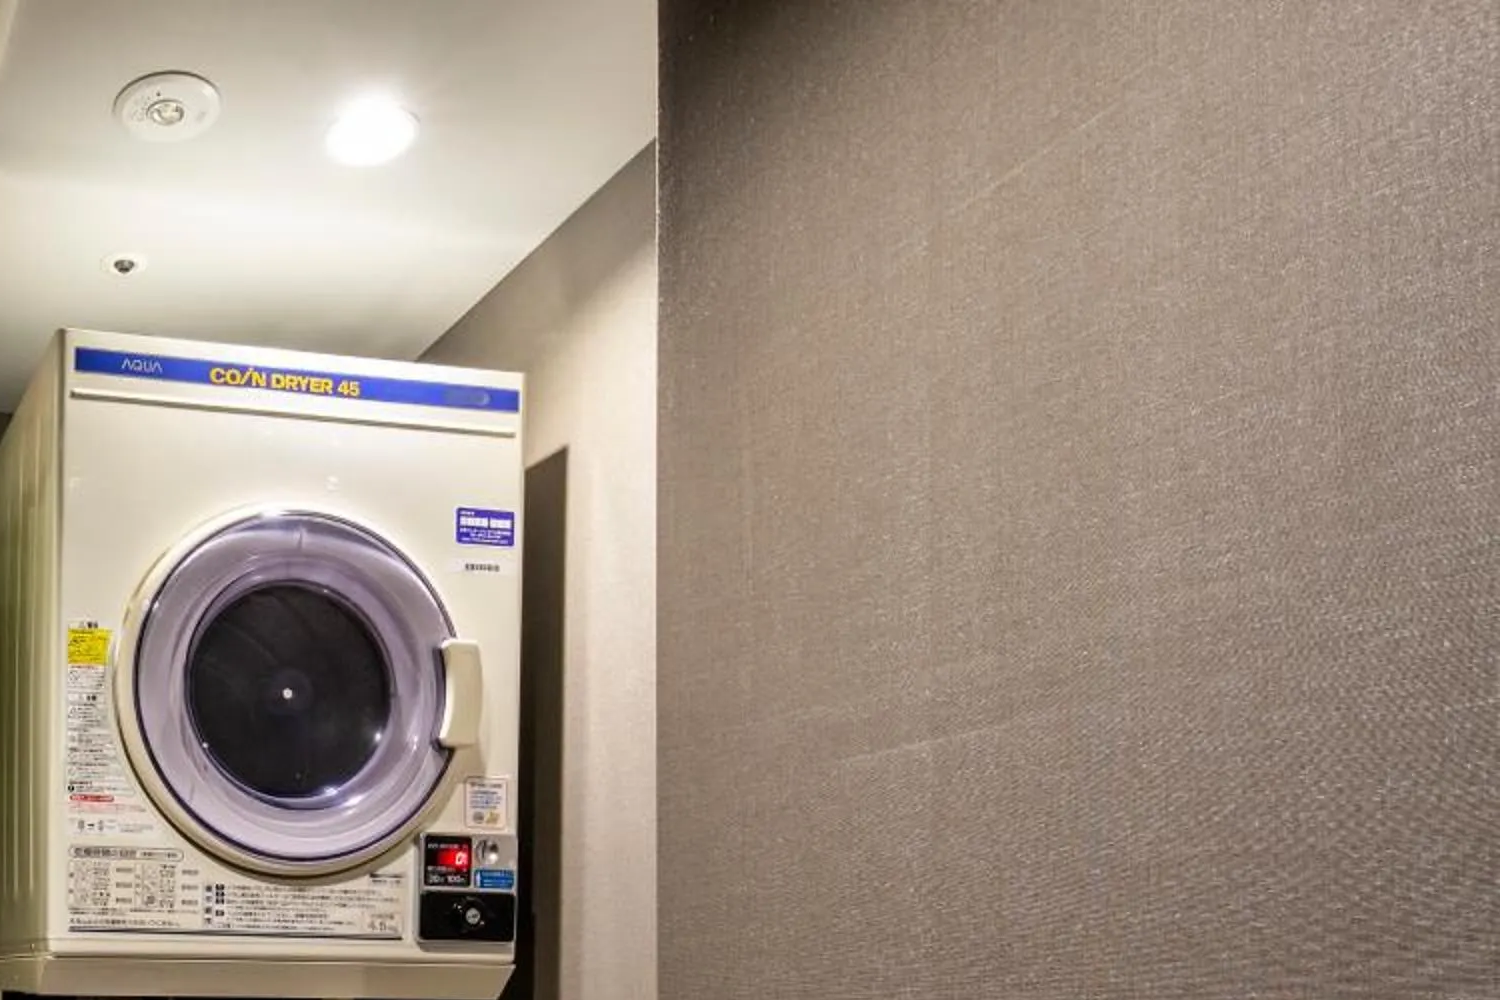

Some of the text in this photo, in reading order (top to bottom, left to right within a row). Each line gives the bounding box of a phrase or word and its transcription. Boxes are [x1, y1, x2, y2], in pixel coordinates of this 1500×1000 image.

[121, 357, 163, 374] AQUA
[271, 374, 334, 395] DRYER
[337, 380, 360, 397] 45
